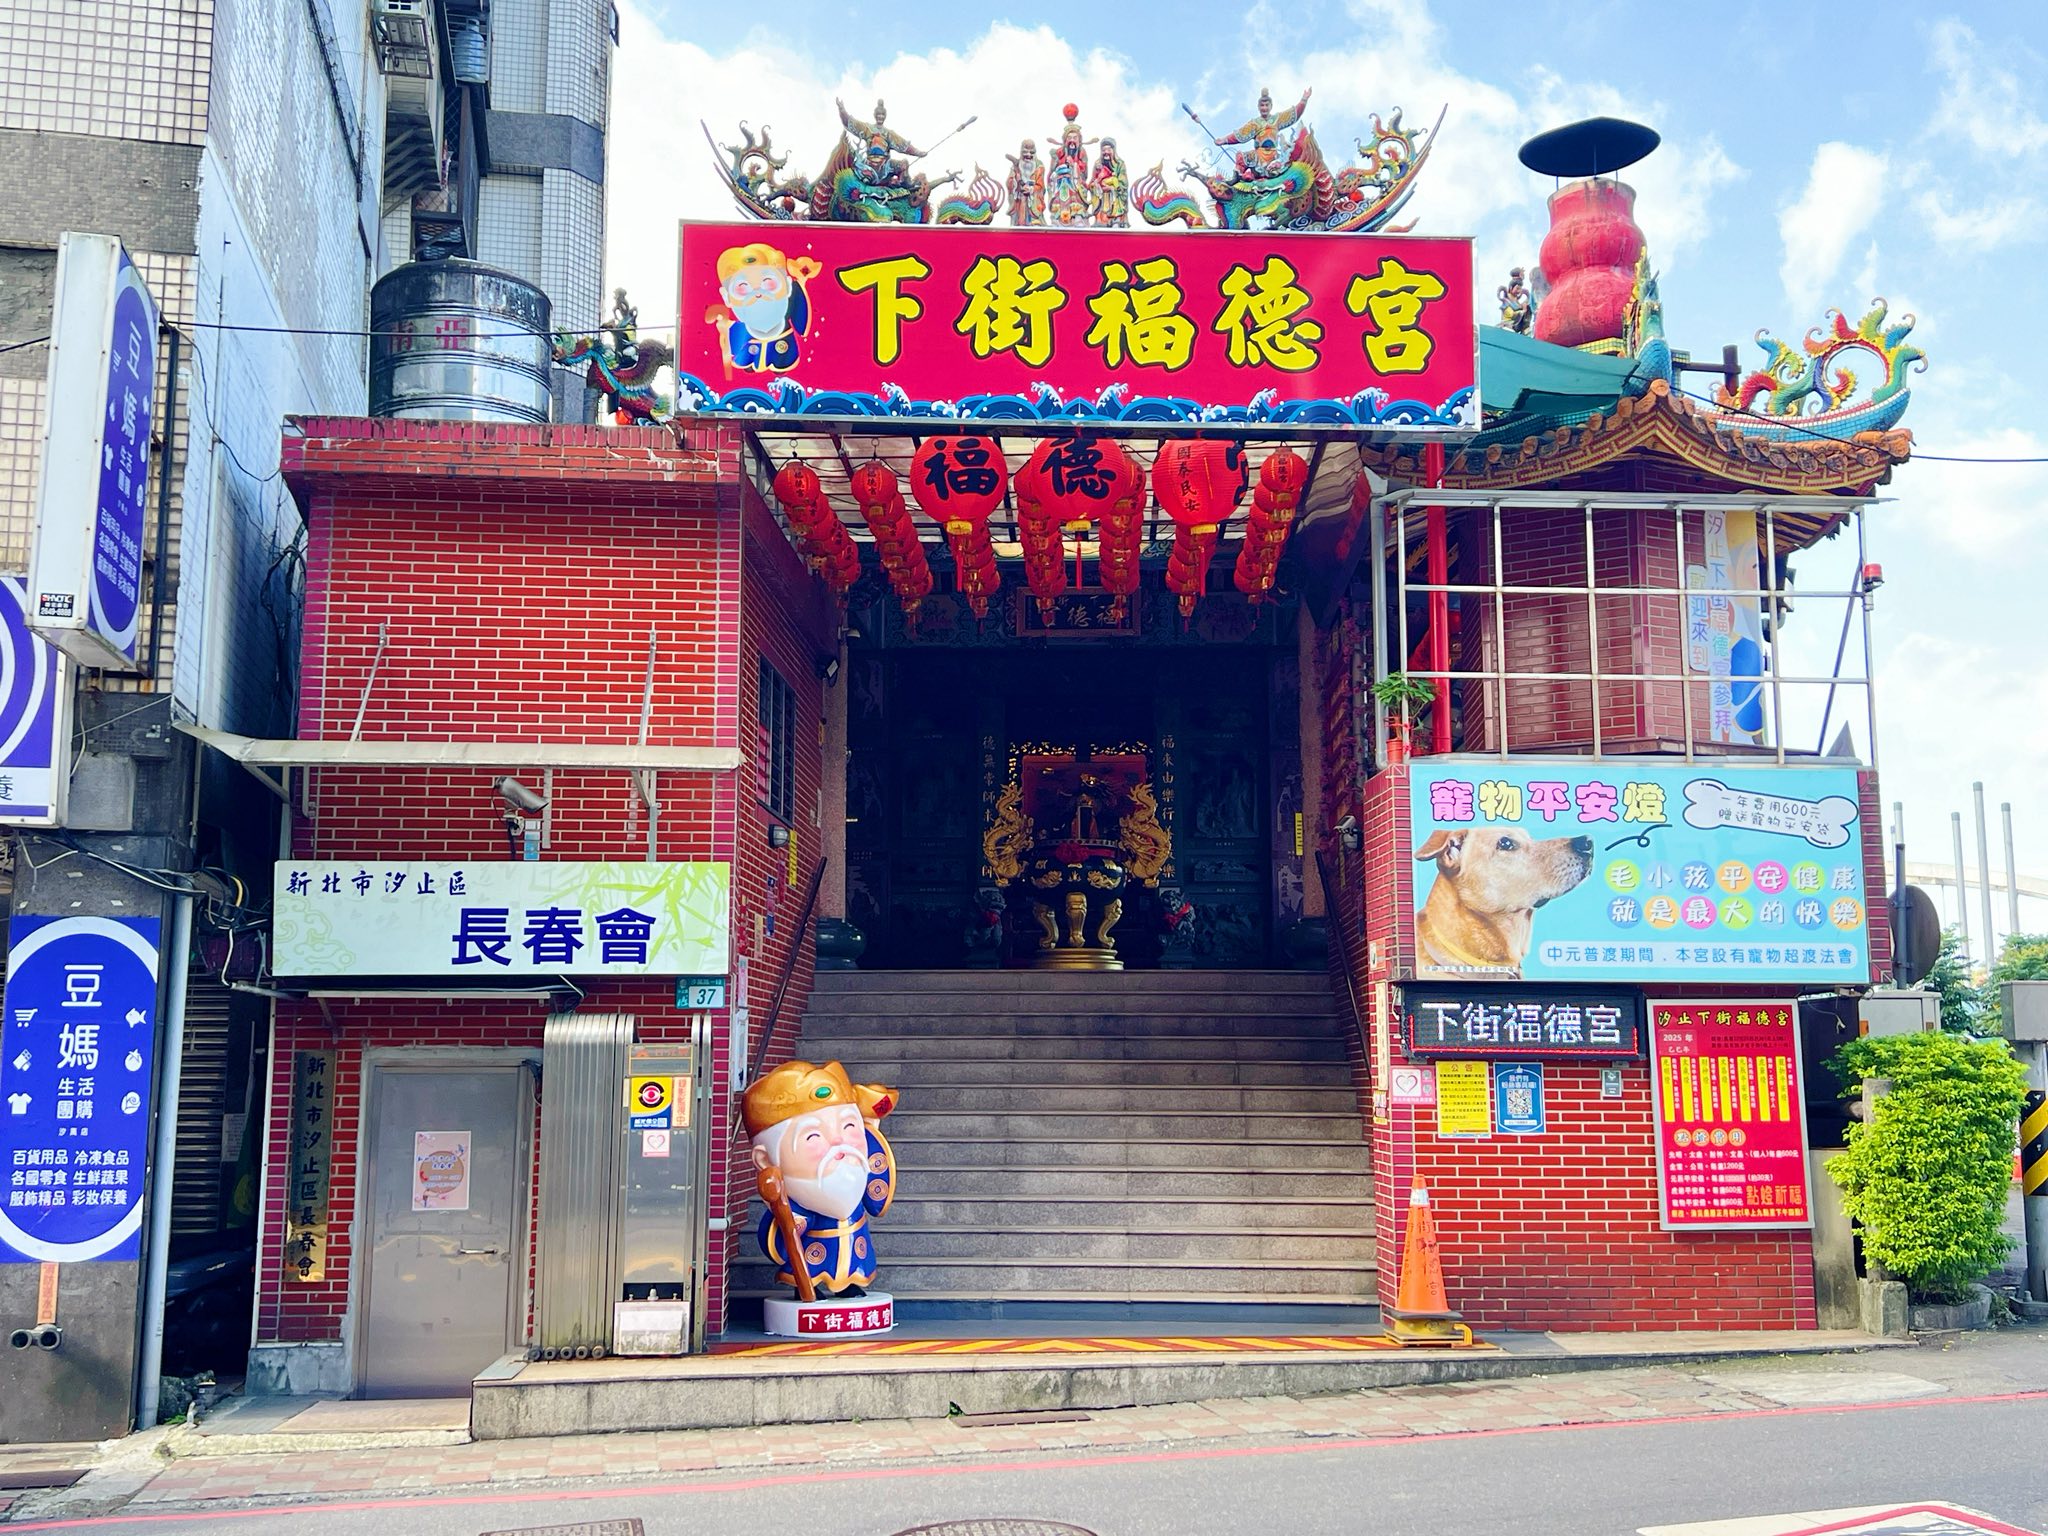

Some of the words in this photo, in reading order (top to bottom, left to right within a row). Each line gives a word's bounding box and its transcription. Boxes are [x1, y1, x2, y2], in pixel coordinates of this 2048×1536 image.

[838, 254, 1447, 375] 下街福德宮
[924, 437, 1000, 501] 福
[1040, 438, 1118, 500] 德
[1177, 445, 1201, 512] 國泰民安
[1430, 778, 1668, 824] 寵物平安燈
[1720, 795, 1821, 819] 一年費用600元
[1718, 807, 1830, 836] 贈送寵物平安袋
[285, 870, 467, 897] 新北市汐止區
[1610, 864, 1857, 893] 毛小孩平安健康
[1611, 897, 1861, 926] 就是最大的快樂
[451, 907, 656, 966] 長春會
[697, 988, 716, 1005] 37
[56, 964, 104, 1071] 豆媽
[1421, 1001, 1622, 1044] 下街福德宮
[1657, 1010, 1789, 1028] 汐止下街福德宮
[1663, 1034, 1682, 1042] 2025
[1684, 1033, 1694, 1043] 年
[1451, 1063, 1474, 1072] 公告
[57, 1077, 96, 1097] 生活
[56, 1099, 94, 1120] 團購
[13, 1149, 69, 1166] 百貨用品
[73, 1149, 130, 1166] 冷凍食品
[296, 1056, 327, 1278] 新北市汐止區長春會
[11, 1169, 67, 1187] 各國零食
[72, 1169, 129, 1186] 生鮮蔬果
[9, 1190, 66, 1207] 服飾精品
[71, 1189, 128, 1206] 彩妝保養
[1745, 1185, 1803, 1206] 點燈祈福
[801, 1308, 892, 1331] 下街福德宮
